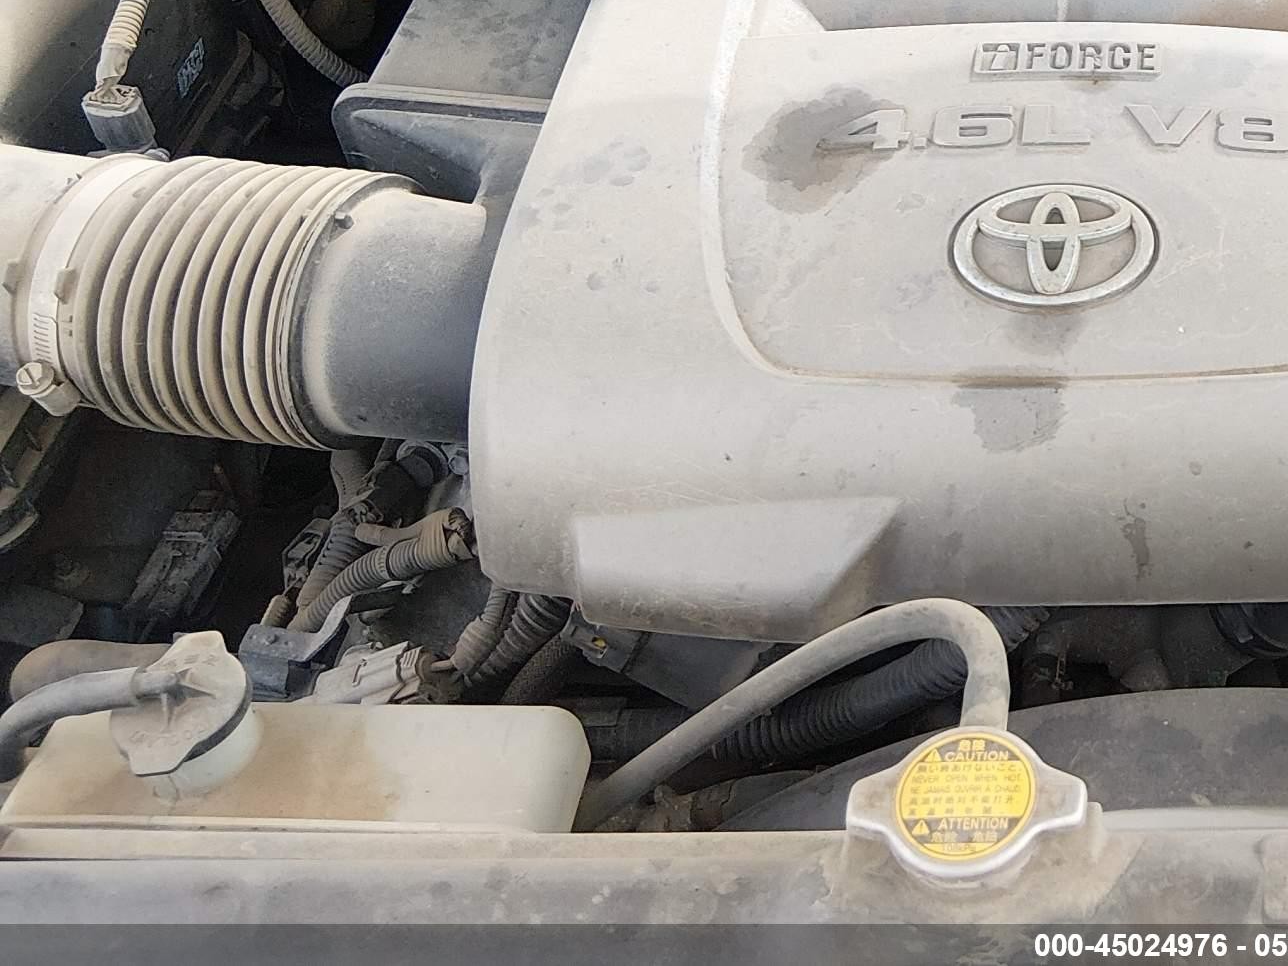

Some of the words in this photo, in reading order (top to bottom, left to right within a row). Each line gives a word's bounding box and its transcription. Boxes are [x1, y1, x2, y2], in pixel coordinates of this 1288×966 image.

[844, 103, 1092, 151] 4.6L
[944, 750, 1009, 762] CAUTION
[911, 774, 940, 783] NEVER
[945, 773, 968, 783] OPEN
[974, 773, 998, 782] WHEN
[937, 817, 1009, 831] ATTENTION
